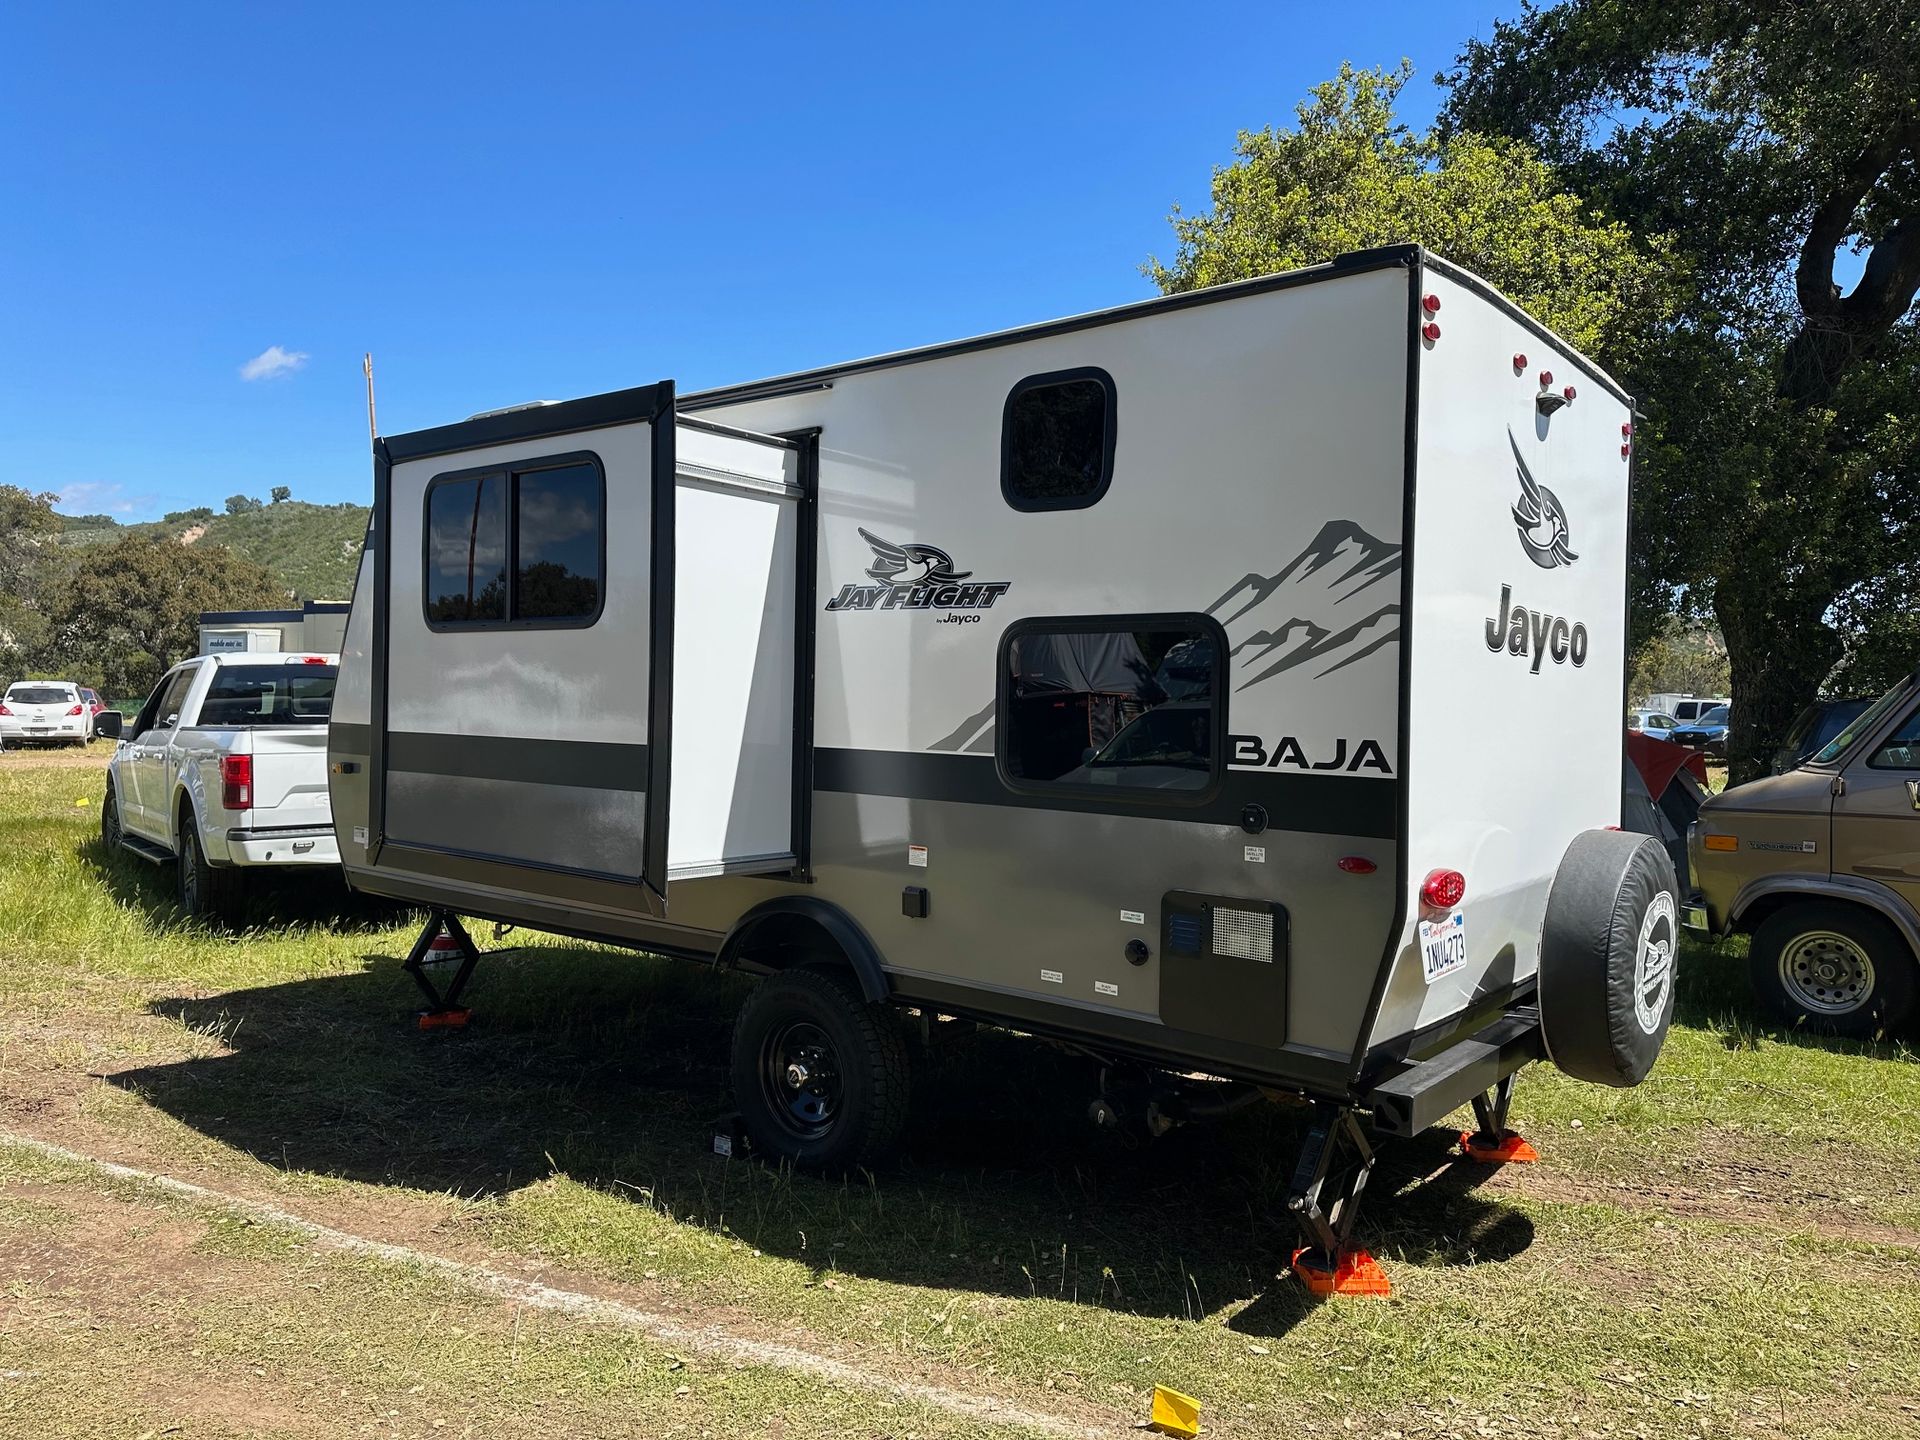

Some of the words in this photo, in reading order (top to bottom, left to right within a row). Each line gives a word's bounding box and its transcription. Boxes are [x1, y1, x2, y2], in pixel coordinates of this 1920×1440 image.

[825, 583, 888, 611] JAY
[881, 581, 1011, 610] FLIGHT
[943, 612, 981, 626] Jayco
[1484, 582, 1588, 674] Jayco
[1228, 735, 1393, 774] BAJA
[1426, 932, 1465, 974] 1NU4273
